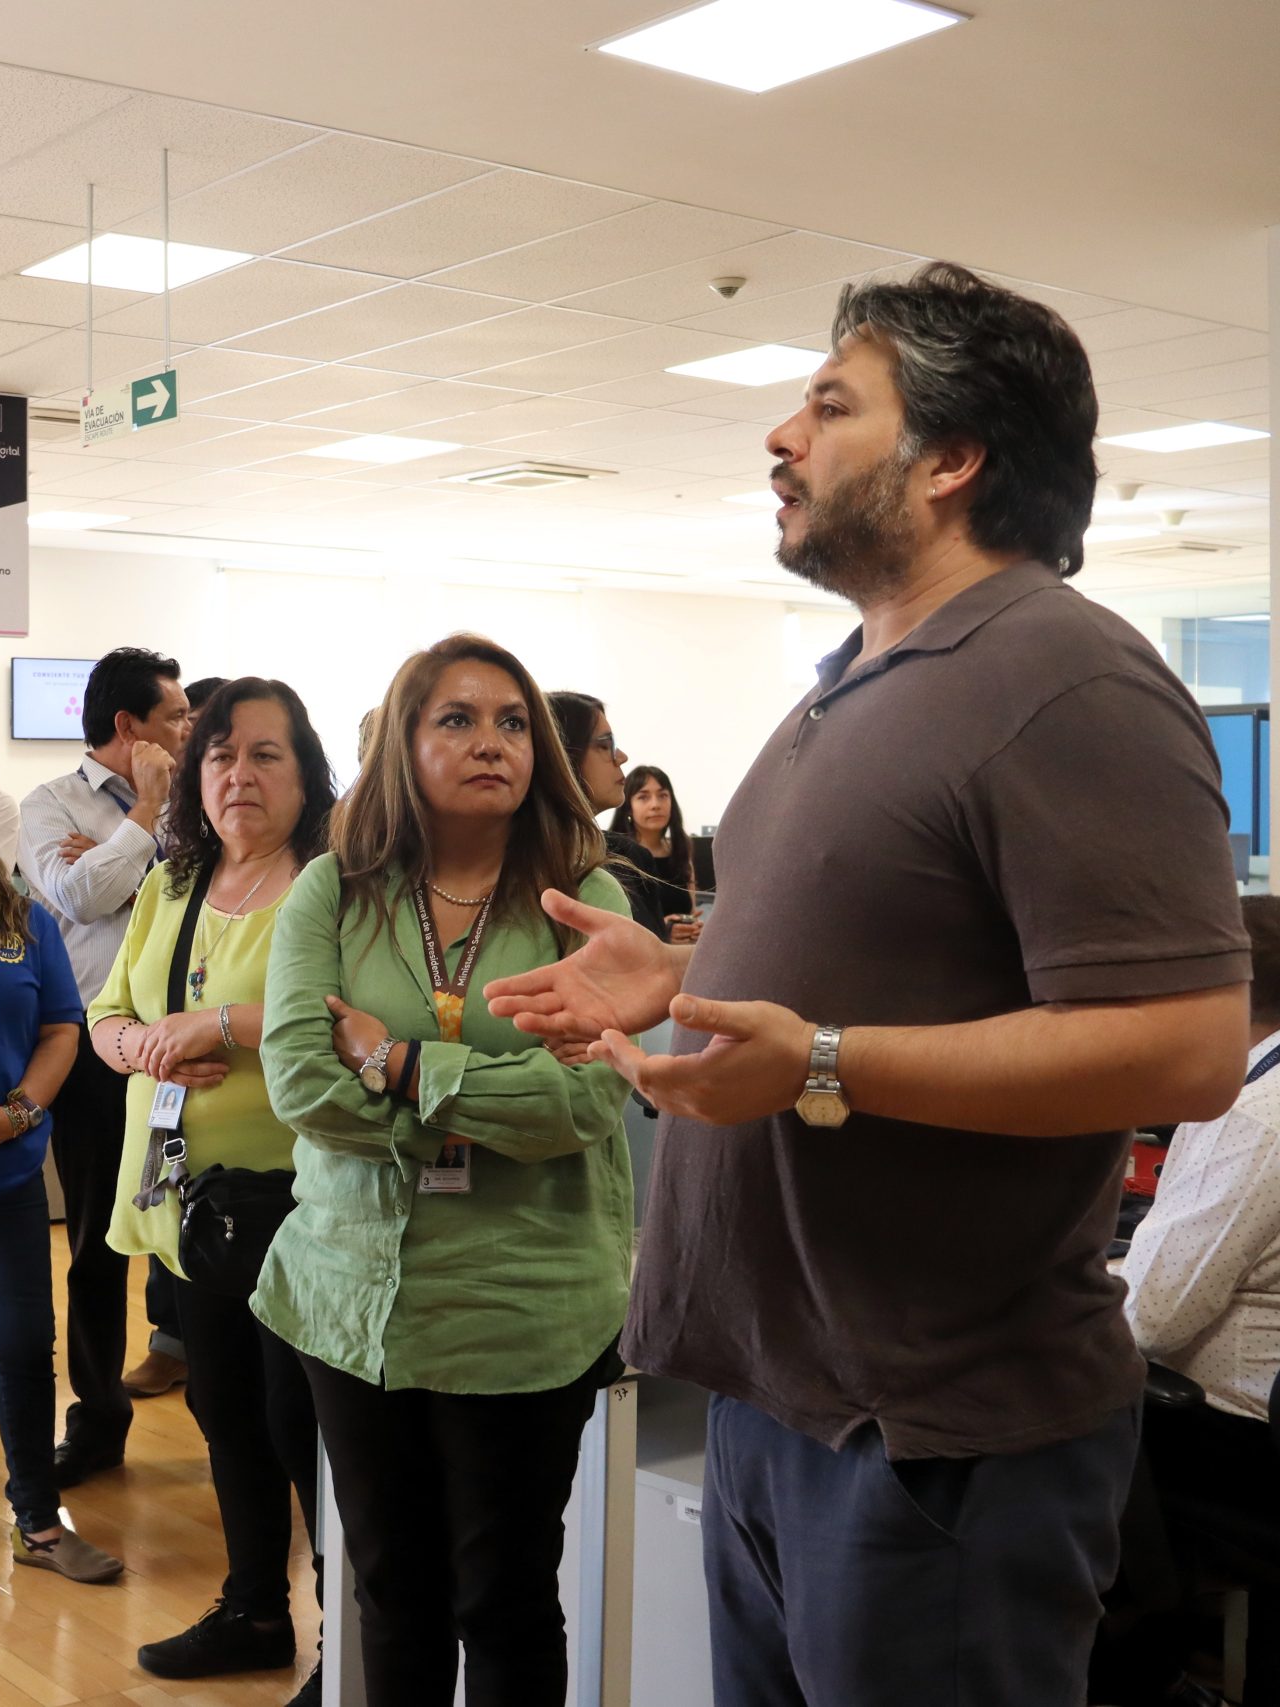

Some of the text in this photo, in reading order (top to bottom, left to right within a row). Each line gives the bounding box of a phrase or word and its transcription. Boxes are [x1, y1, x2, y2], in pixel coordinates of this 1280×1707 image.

[84, 410, 124, 431] EVACUACIÓN
[95, 405, 104, 416] DE
[415, 890, 429, 920] General
[423, 921, 431, 932] de
[425, 933, 432, 941] la
[427, 941, 444, 987] Presidencia
[457, 946, 477, 986] Ministerio
